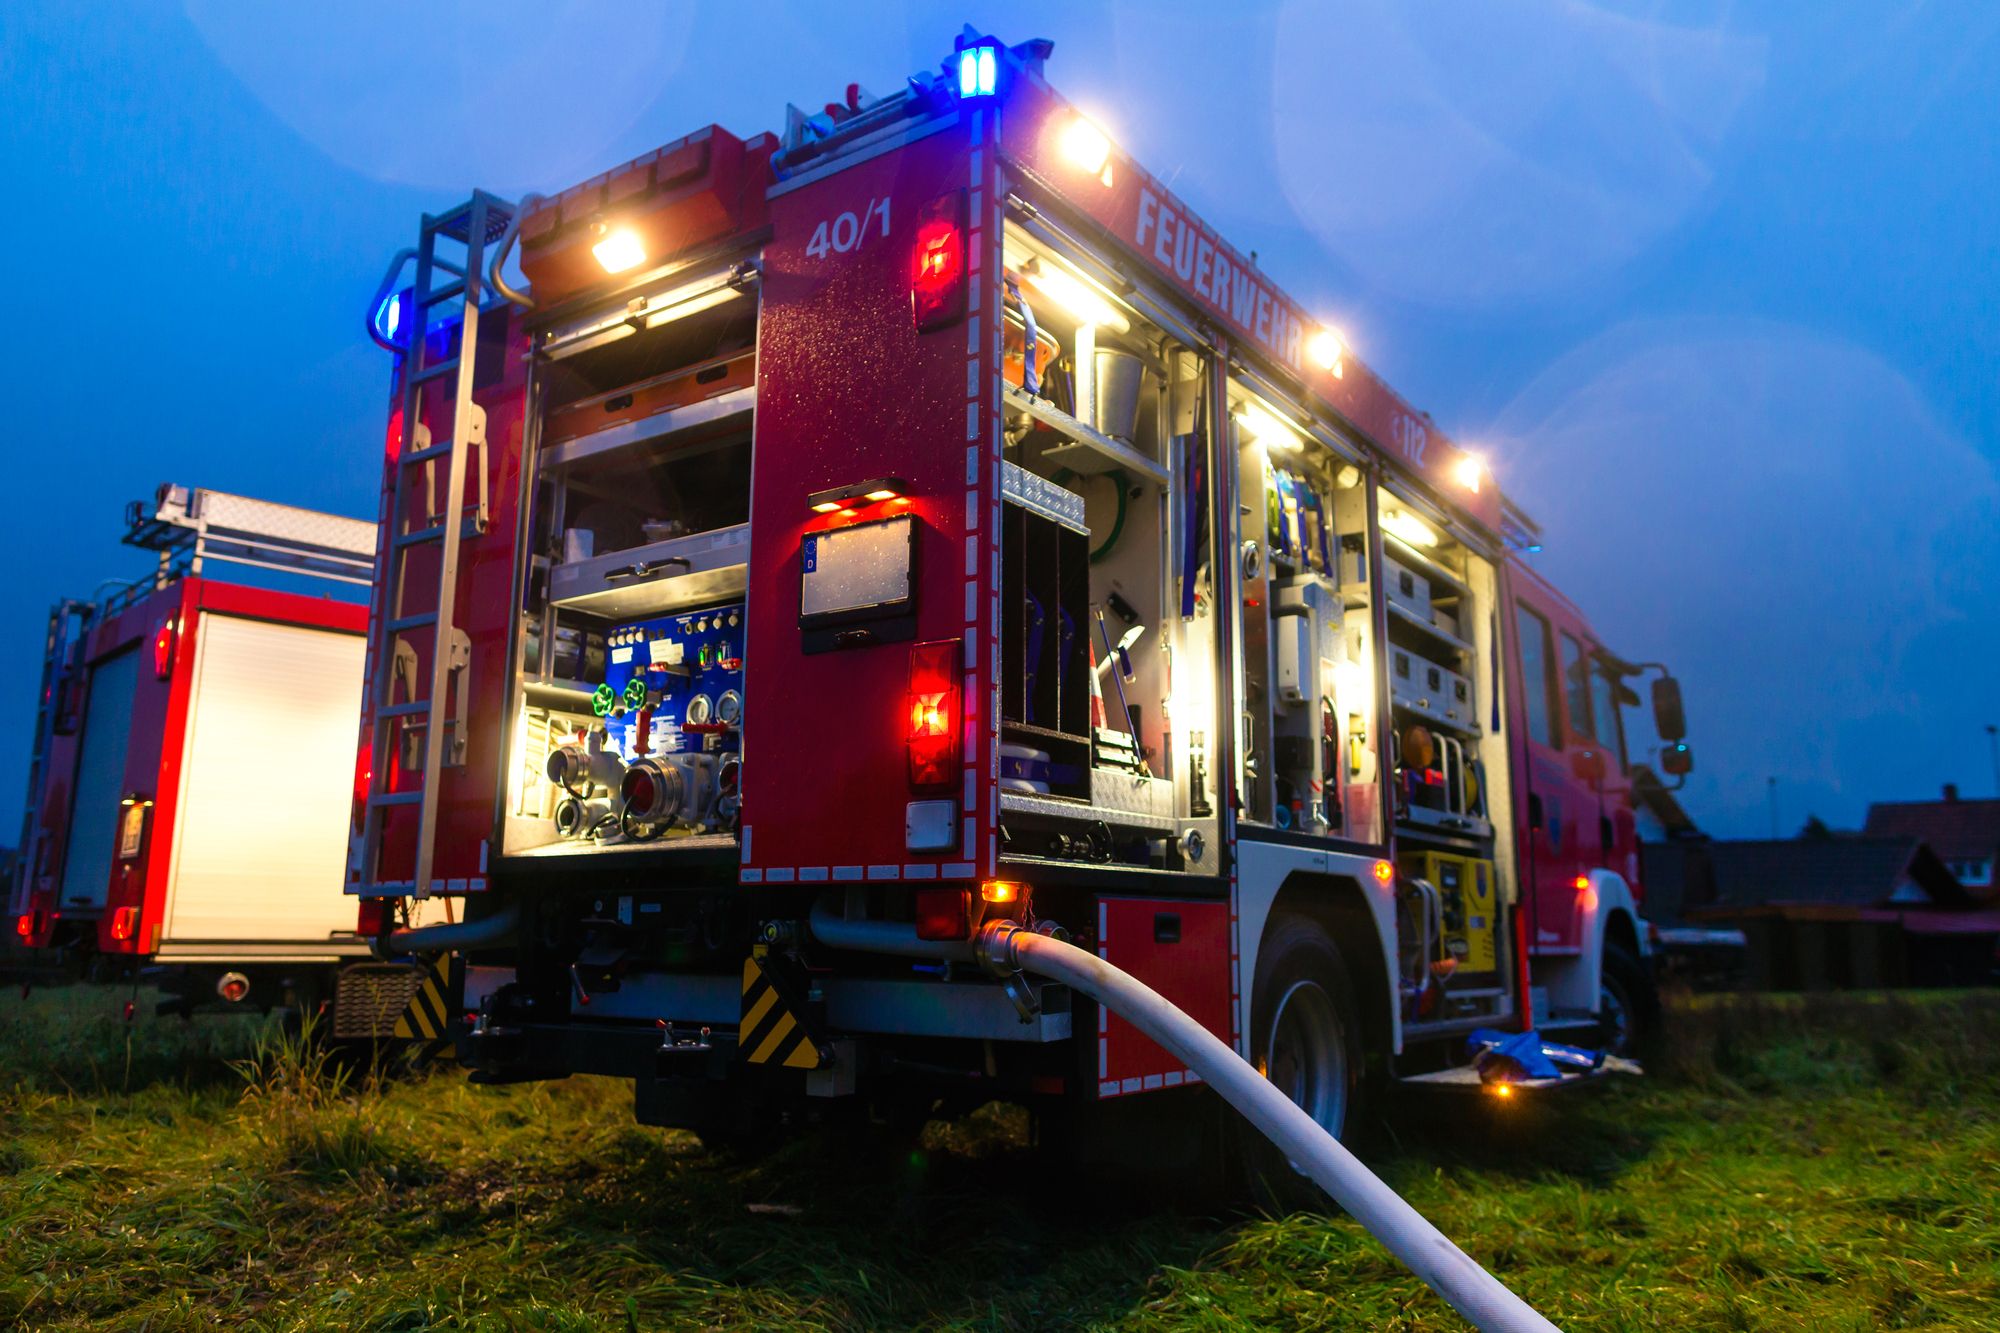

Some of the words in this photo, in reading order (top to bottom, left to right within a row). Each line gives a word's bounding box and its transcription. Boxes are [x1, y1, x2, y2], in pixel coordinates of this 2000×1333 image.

[806, 197, 891, 259] 40/1
[1136, 187, 1303, 371] FEUERWEHR
[1403, 414, 1426, 469] 112
[807, 559, 814, 569] D
